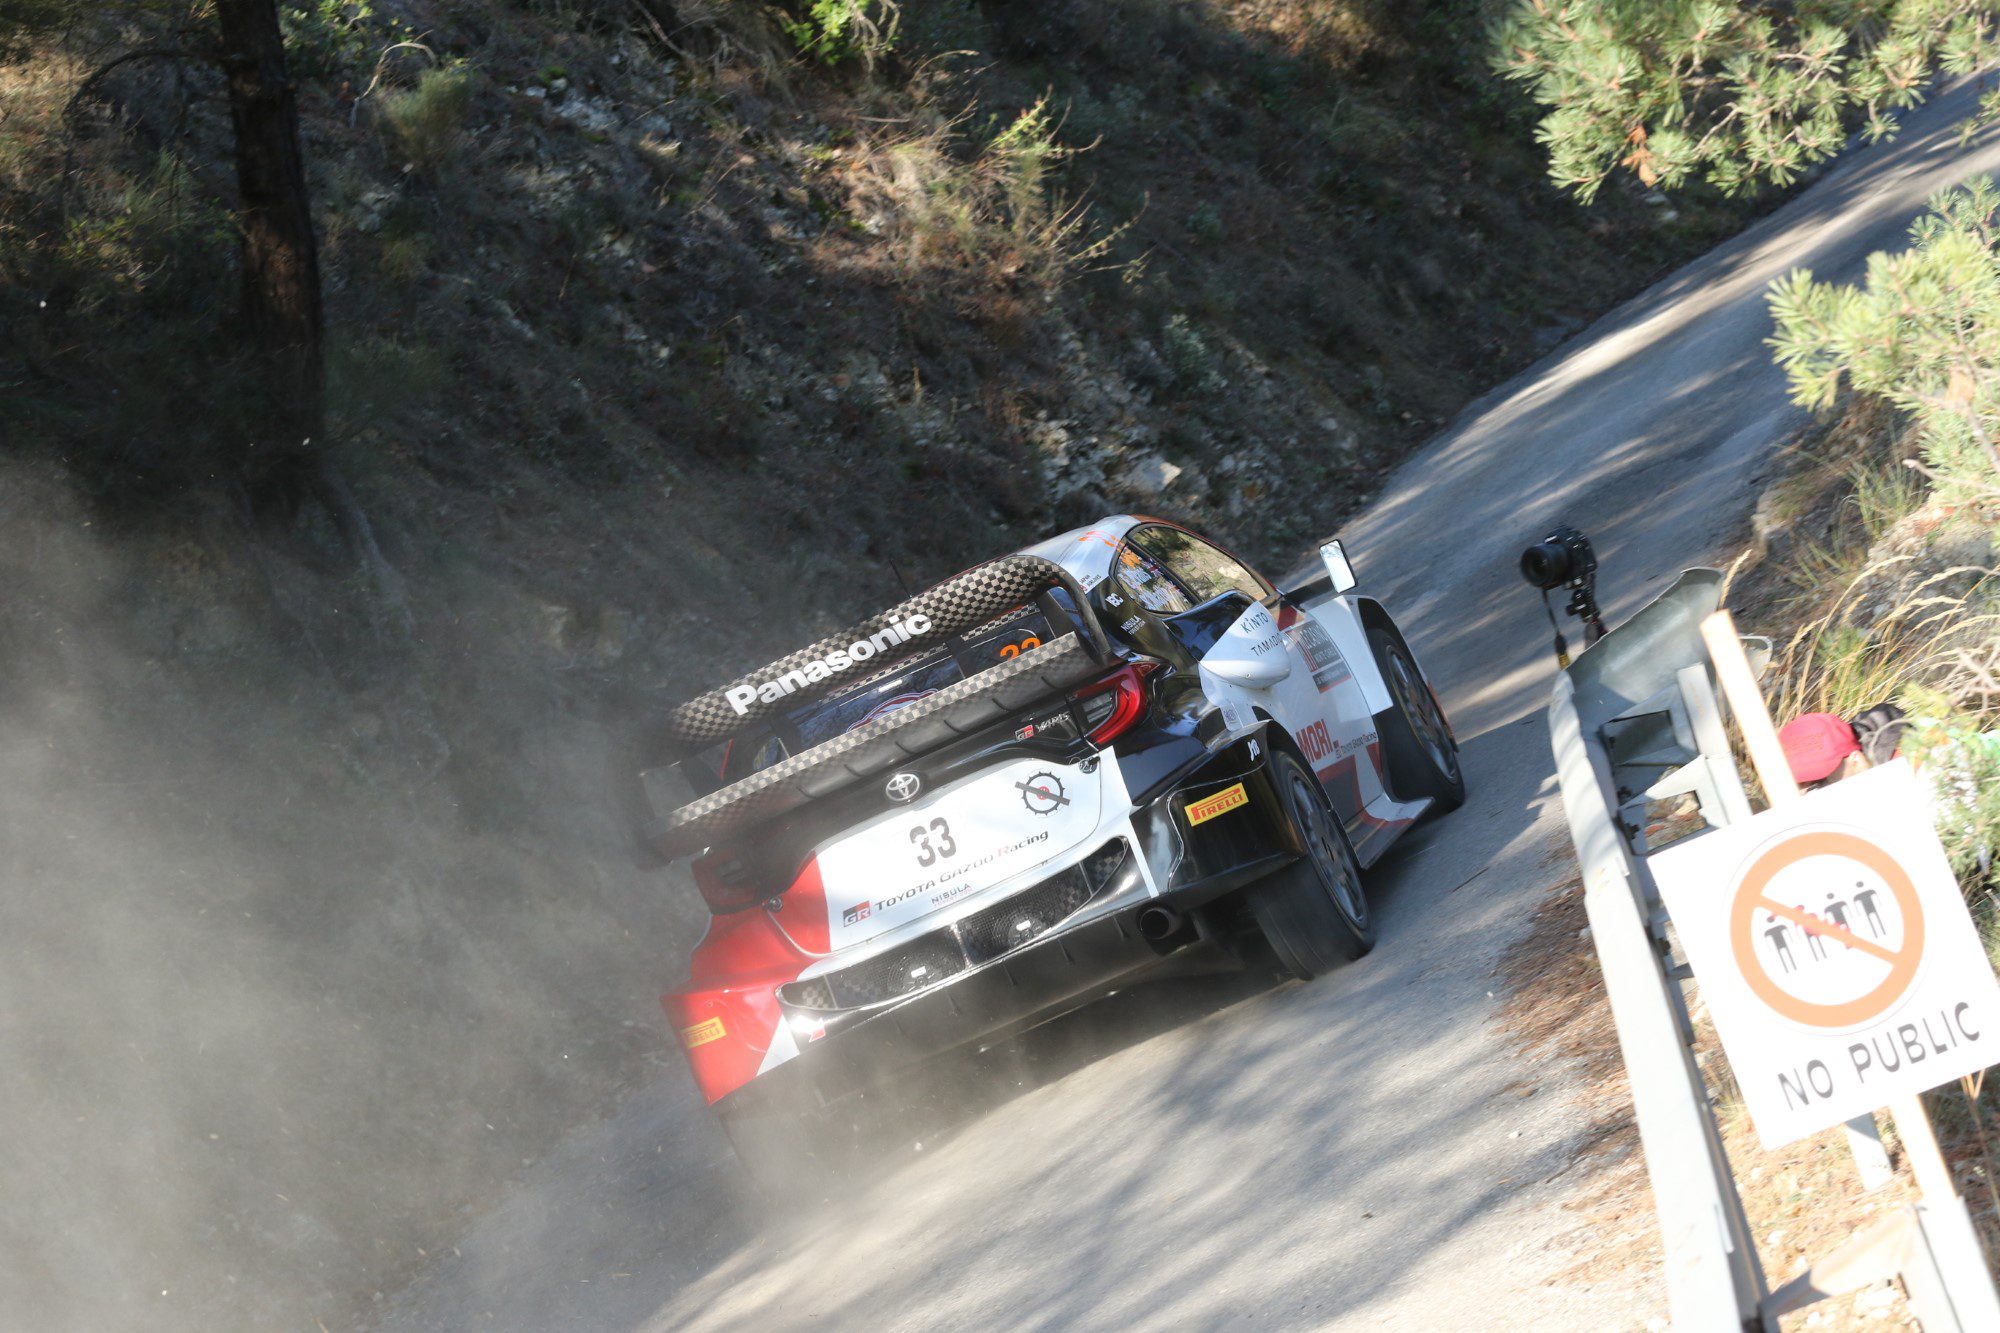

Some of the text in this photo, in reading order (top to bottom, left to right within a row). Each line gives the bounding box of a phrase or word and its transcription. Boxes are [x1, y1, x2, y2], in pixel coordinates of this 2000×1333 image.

[725, 614, 932, 716] Panasonic
[909, 816, 957, 868] 33
[1190, 788, 1244, 821] PIRELLI
[844, 830, 1049, 927] GR TOYOTA GAZOO Racing
[1777, 1001, 1980, 1111] NO PUBLIC
